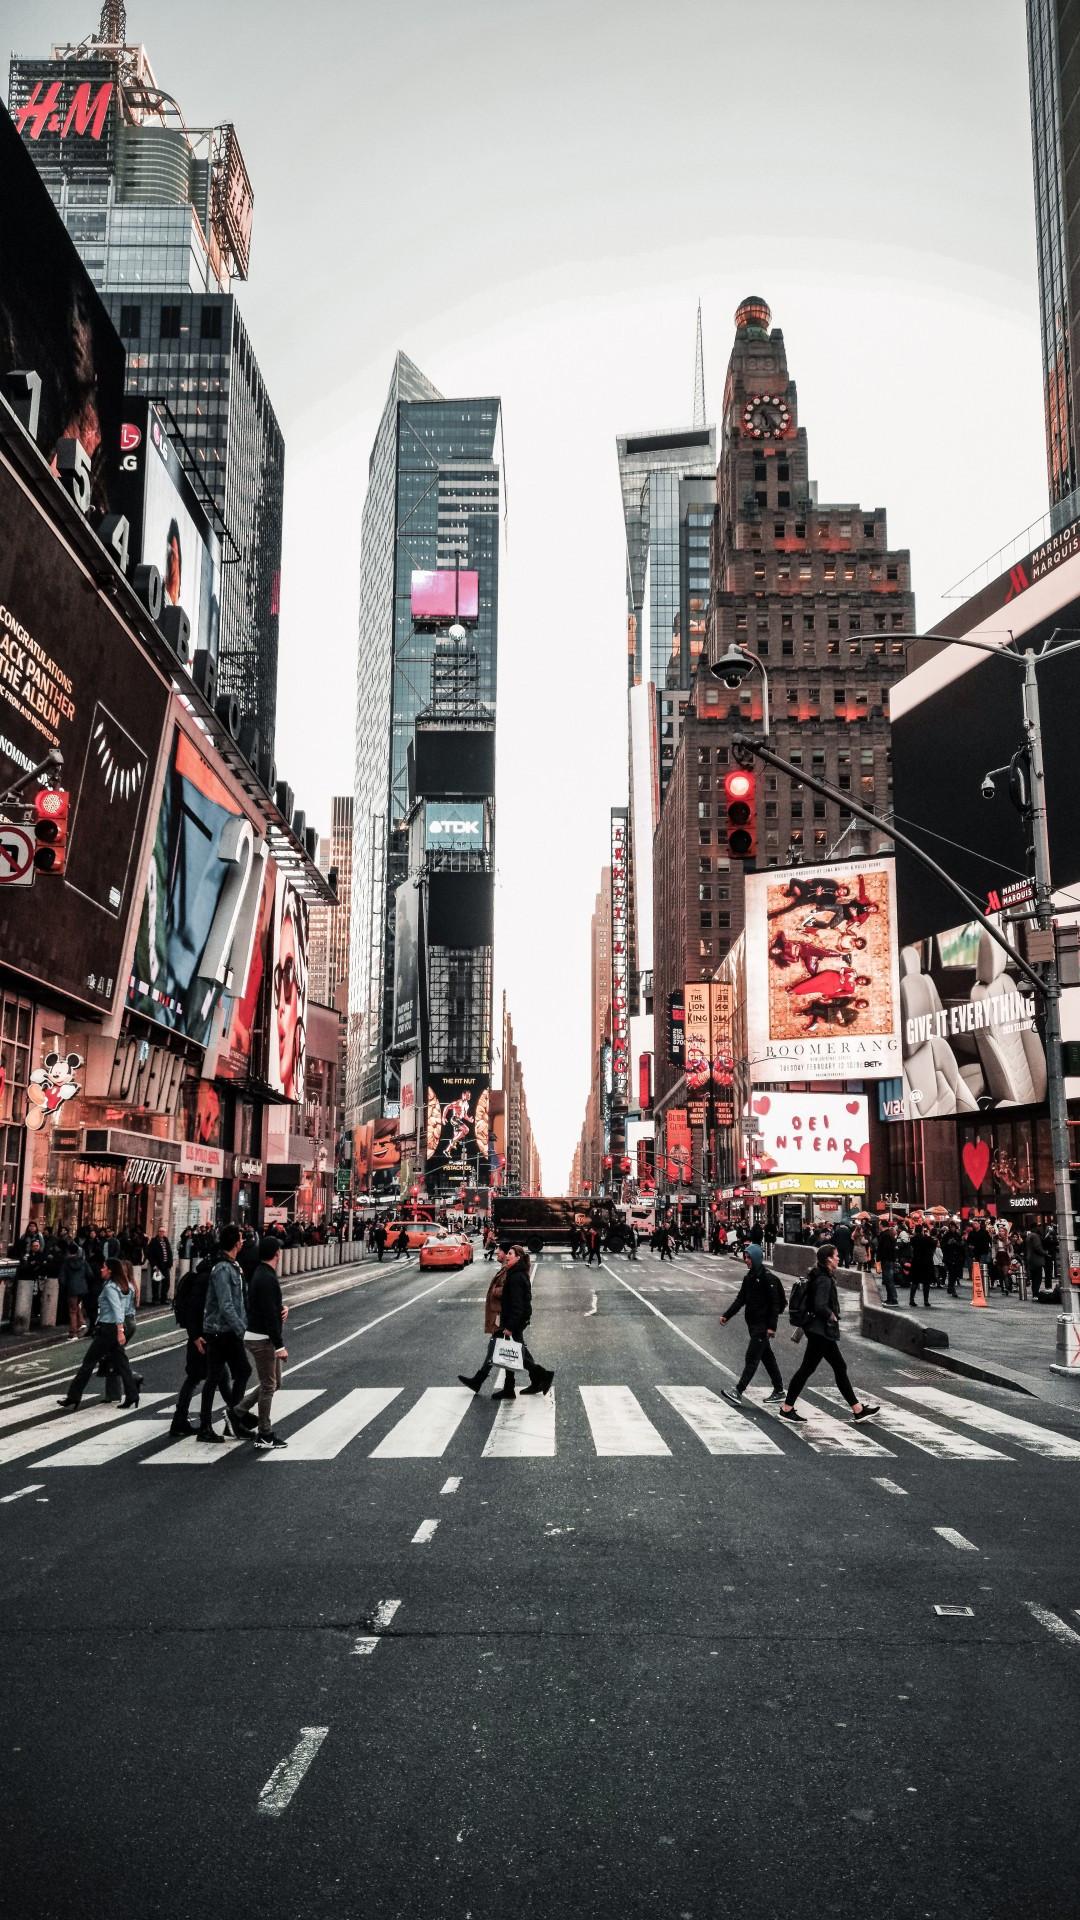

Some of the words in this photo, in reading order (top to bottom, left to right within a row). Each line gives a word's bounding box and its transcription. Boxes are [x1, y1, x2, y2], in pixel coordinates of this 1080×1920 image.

[17, 82, 114, 140] H&M
[119, 455, 137, 471] G
[1031, 519, 1080, 565] MARRIOT
[1031, 537, 1080, 580] MARQUIS
[0, 605, 73, 694] CONGRATULATIONS
[26, 658, 76, 721] PANTHER
[22, 680, 60, 729] ALBUM
[441, 821, 479, 833] TDK
[1003, 888, 1033, 905] MARQUIS
[689, 1002, 705, 1012] LION
[906, 1013, 933, 1044] GIVE
[935, 1009, 948, 1037] IT
[951, 990, 1035, 1035] EVERYTHING
[688, 1013, 707, 1025] KING
[766, 1040, 898, 1057] BOOMERANG
[807, 1063, 836, 1071] FEBRUARY
[128, 1158, 160, 1185] FOREVER
[1010, 1197, 1034, 1207] swatch
